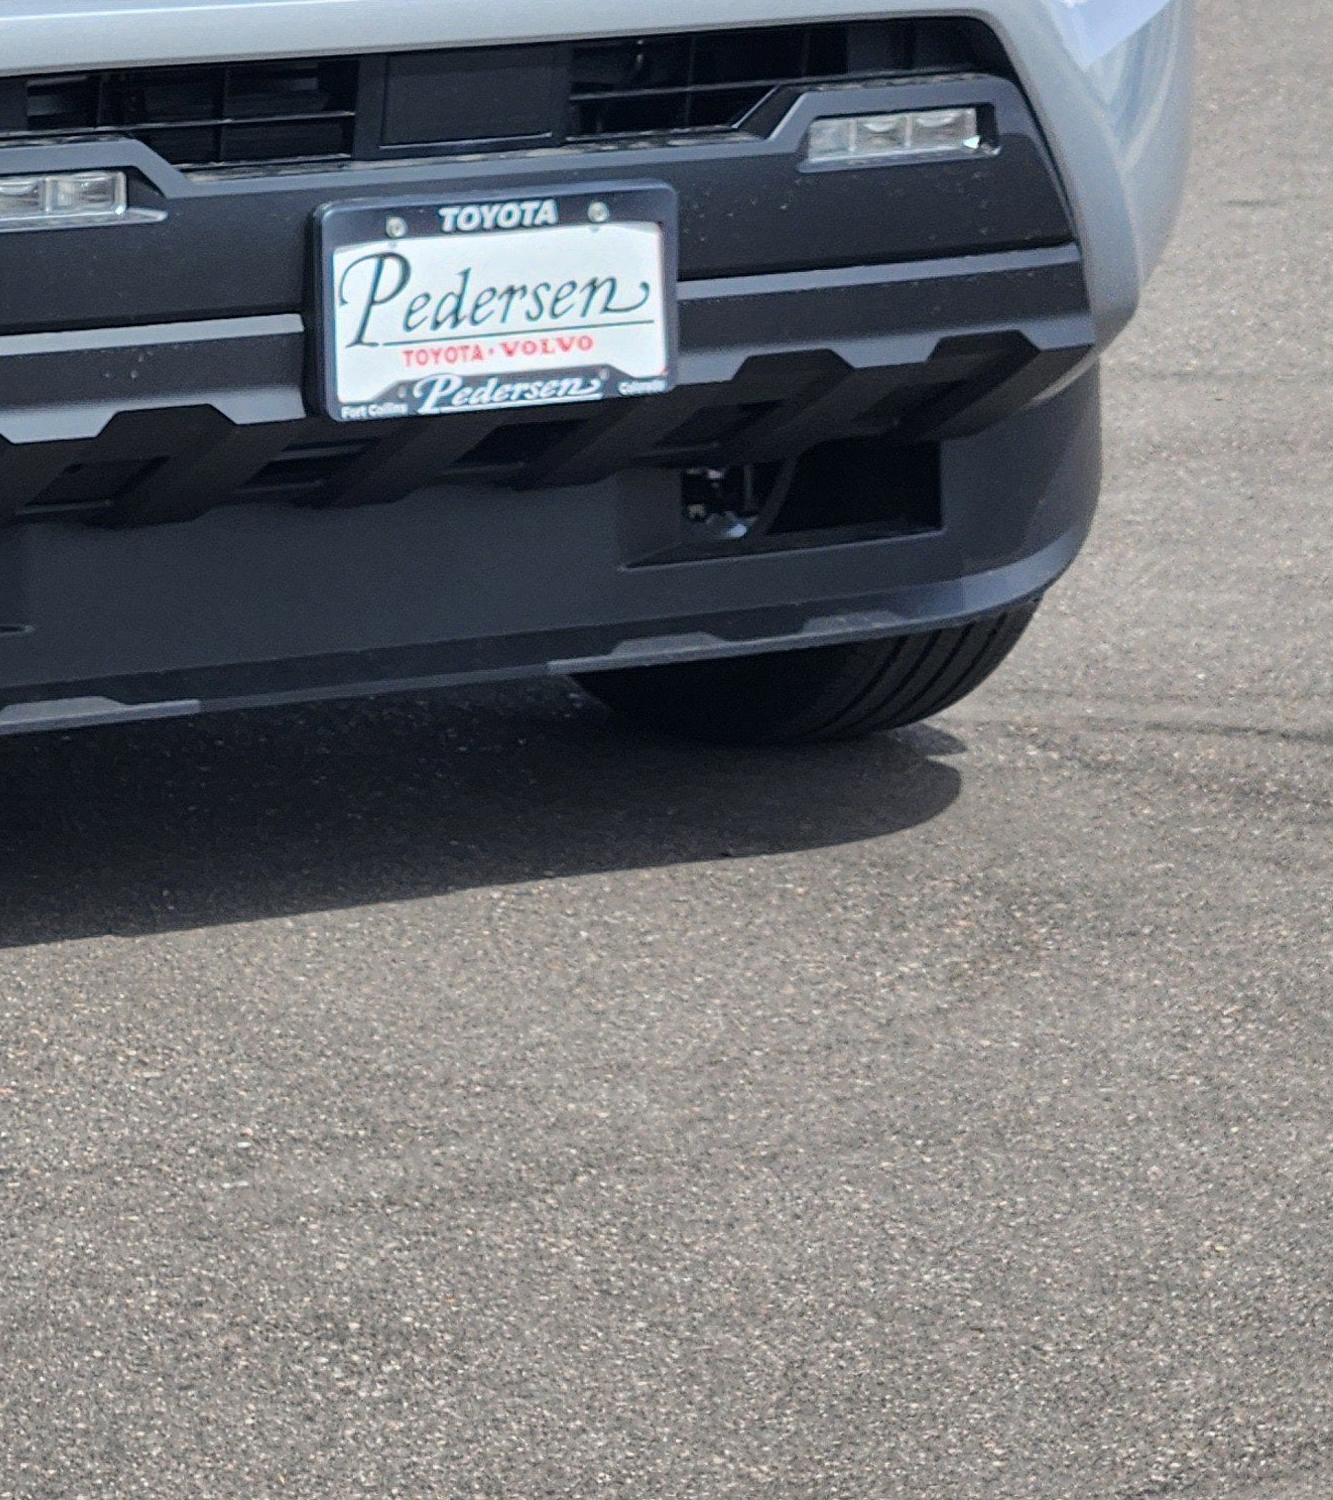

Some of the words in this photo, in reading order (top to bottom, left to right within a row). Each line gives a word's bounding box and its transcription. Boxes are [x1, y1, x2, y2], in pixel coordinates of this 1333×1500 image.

[438, 200, 558, 233] TOYOTA
[339, 251, 651, 348] Pedersen
[403, 344, 484, 367] TOYOTA
[500, 335, 594, 357] VOLVO
[413, 374, 603, 414] Pedersen
[341, 403, 367, 419] Fort
